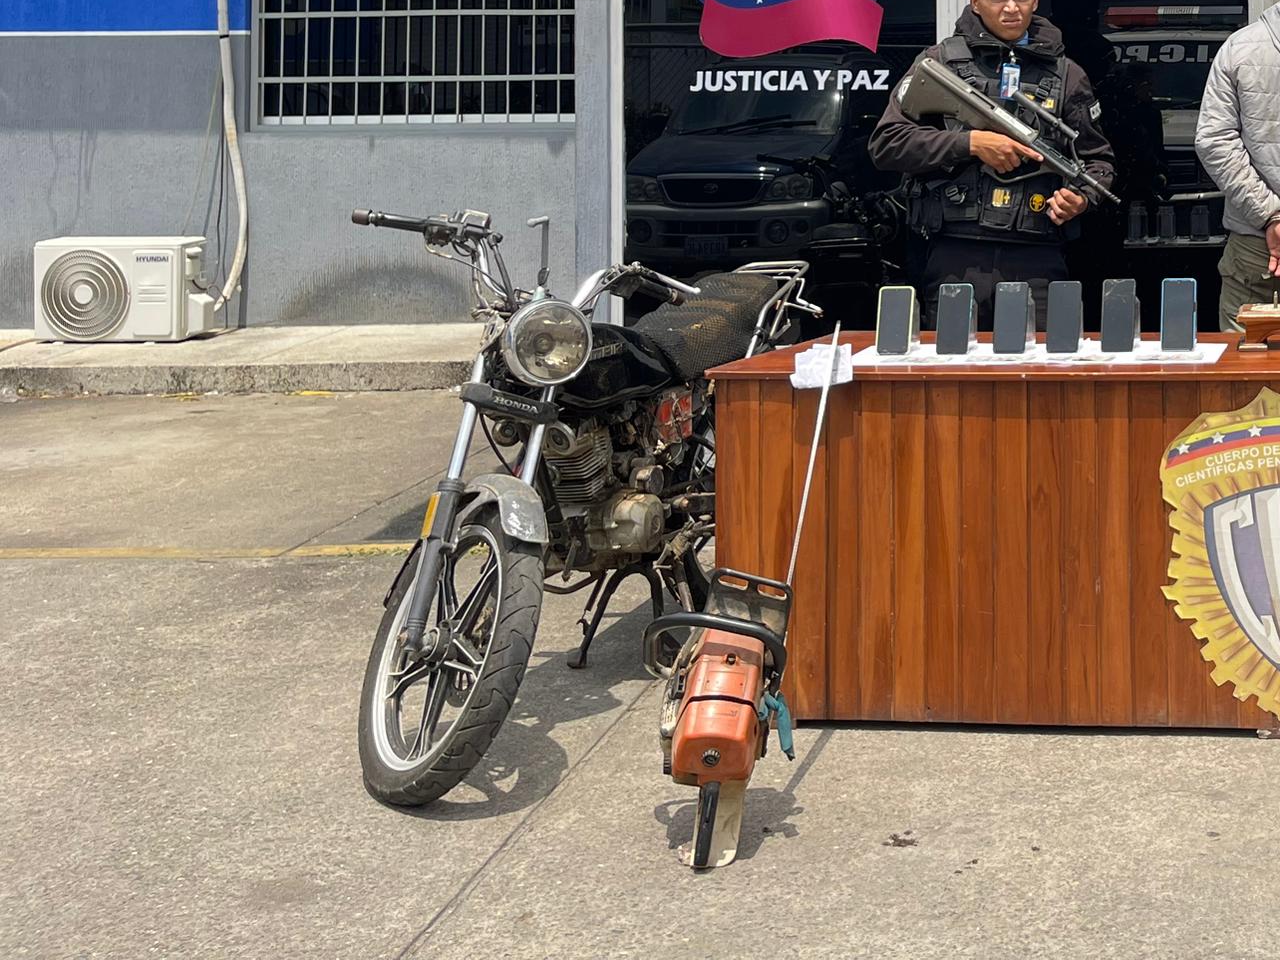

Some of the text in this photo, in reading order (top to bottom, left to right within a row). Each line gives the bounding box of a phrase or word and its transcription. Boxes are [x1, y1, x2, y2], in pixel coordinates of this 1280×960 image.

[690, 69, 890, 92] JUSTICIA Y PAZ
[136, 255, 169, 263] HYUNDAI
[493, 395, 539, 415] HONDA
[1205, 446, 1260, 468] CUERPO
[1263, 444, 1280, 457] DE
